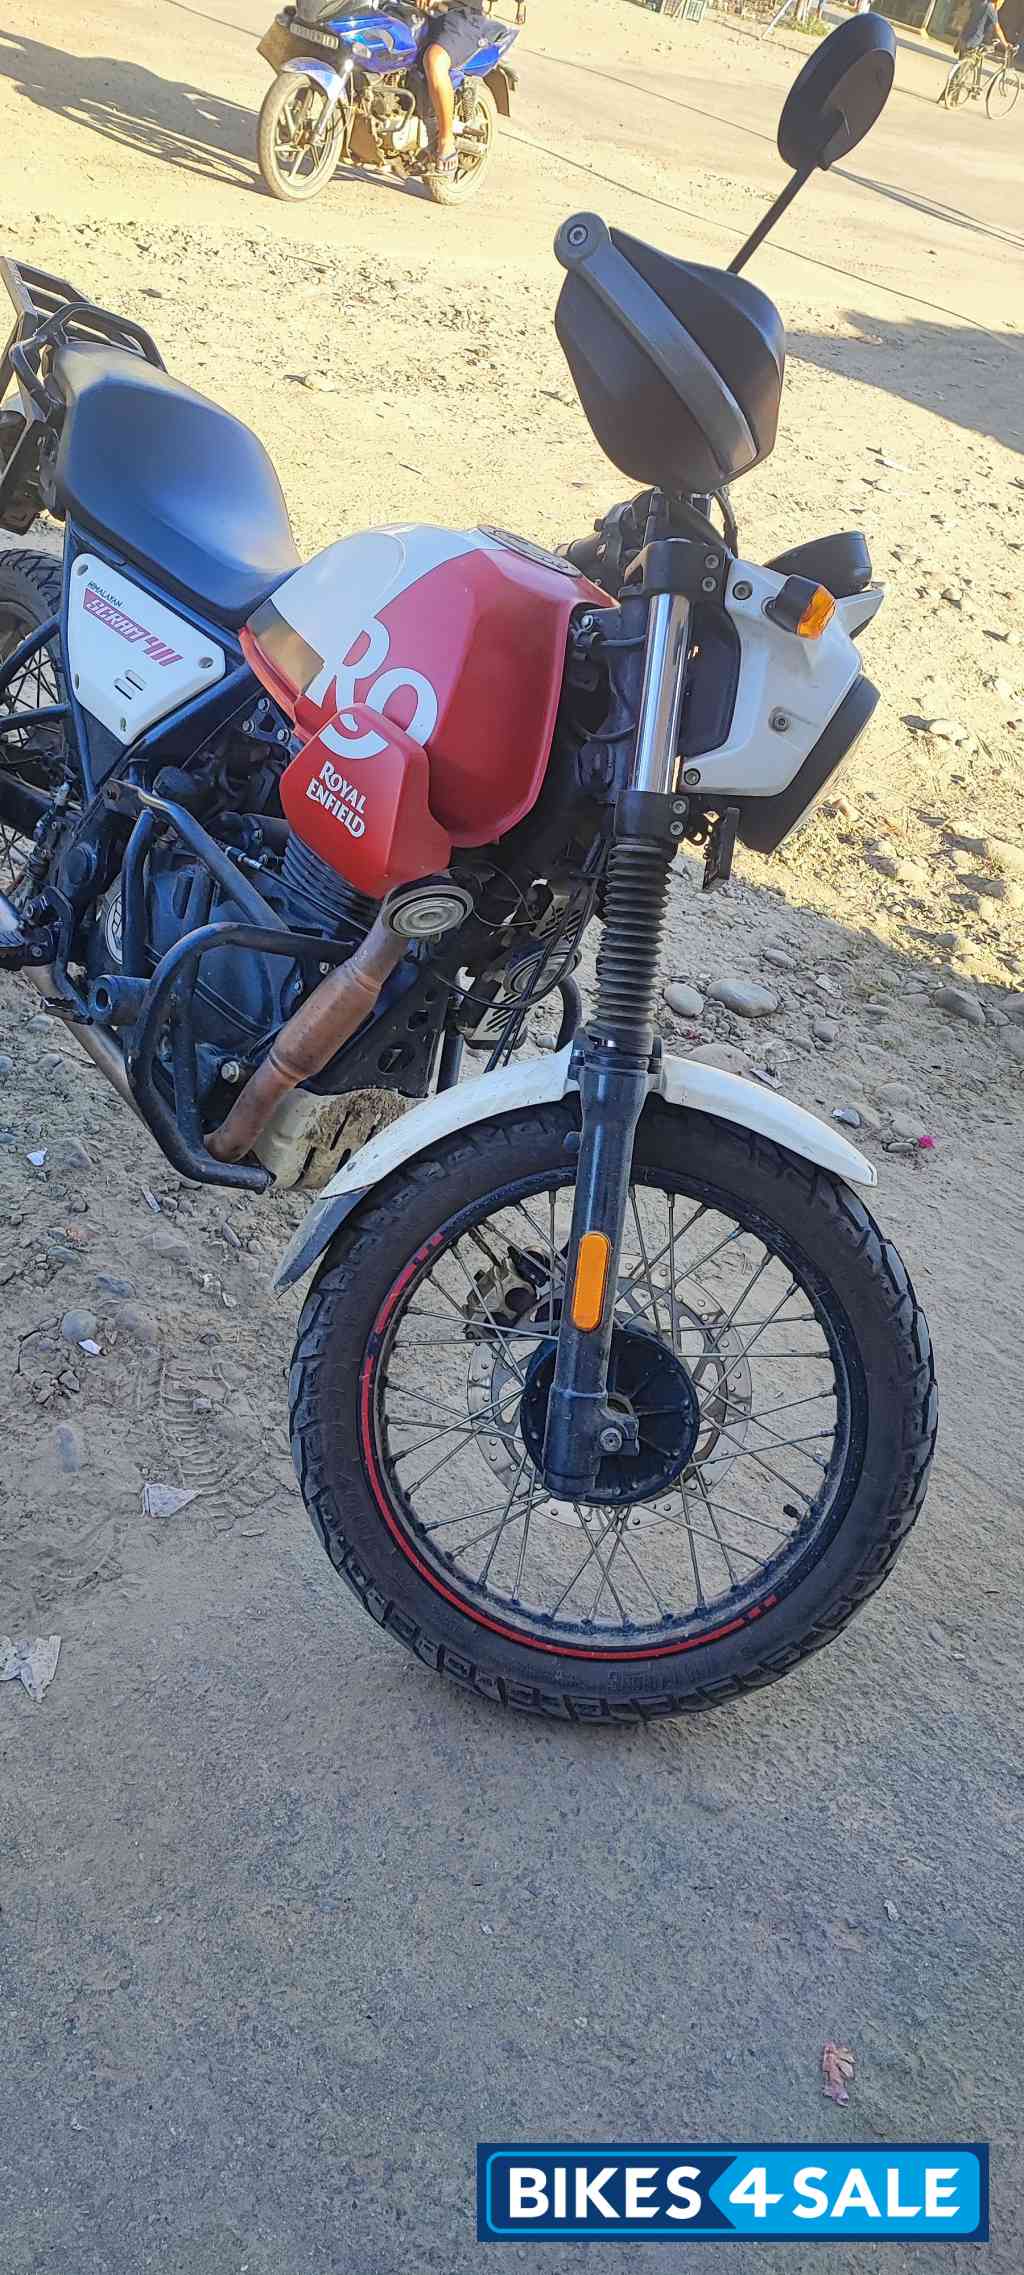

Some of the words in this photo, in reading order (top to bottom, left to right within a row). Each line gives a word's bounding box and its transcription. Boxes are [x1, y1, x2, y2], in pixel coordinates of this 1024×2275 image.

[86, 598, 147, 642] SCRAM
[143, 635, 185, 667] 411
[305, 777, 366, 839] ENFIELD
[319, 760, 367, 815] ROYAL
